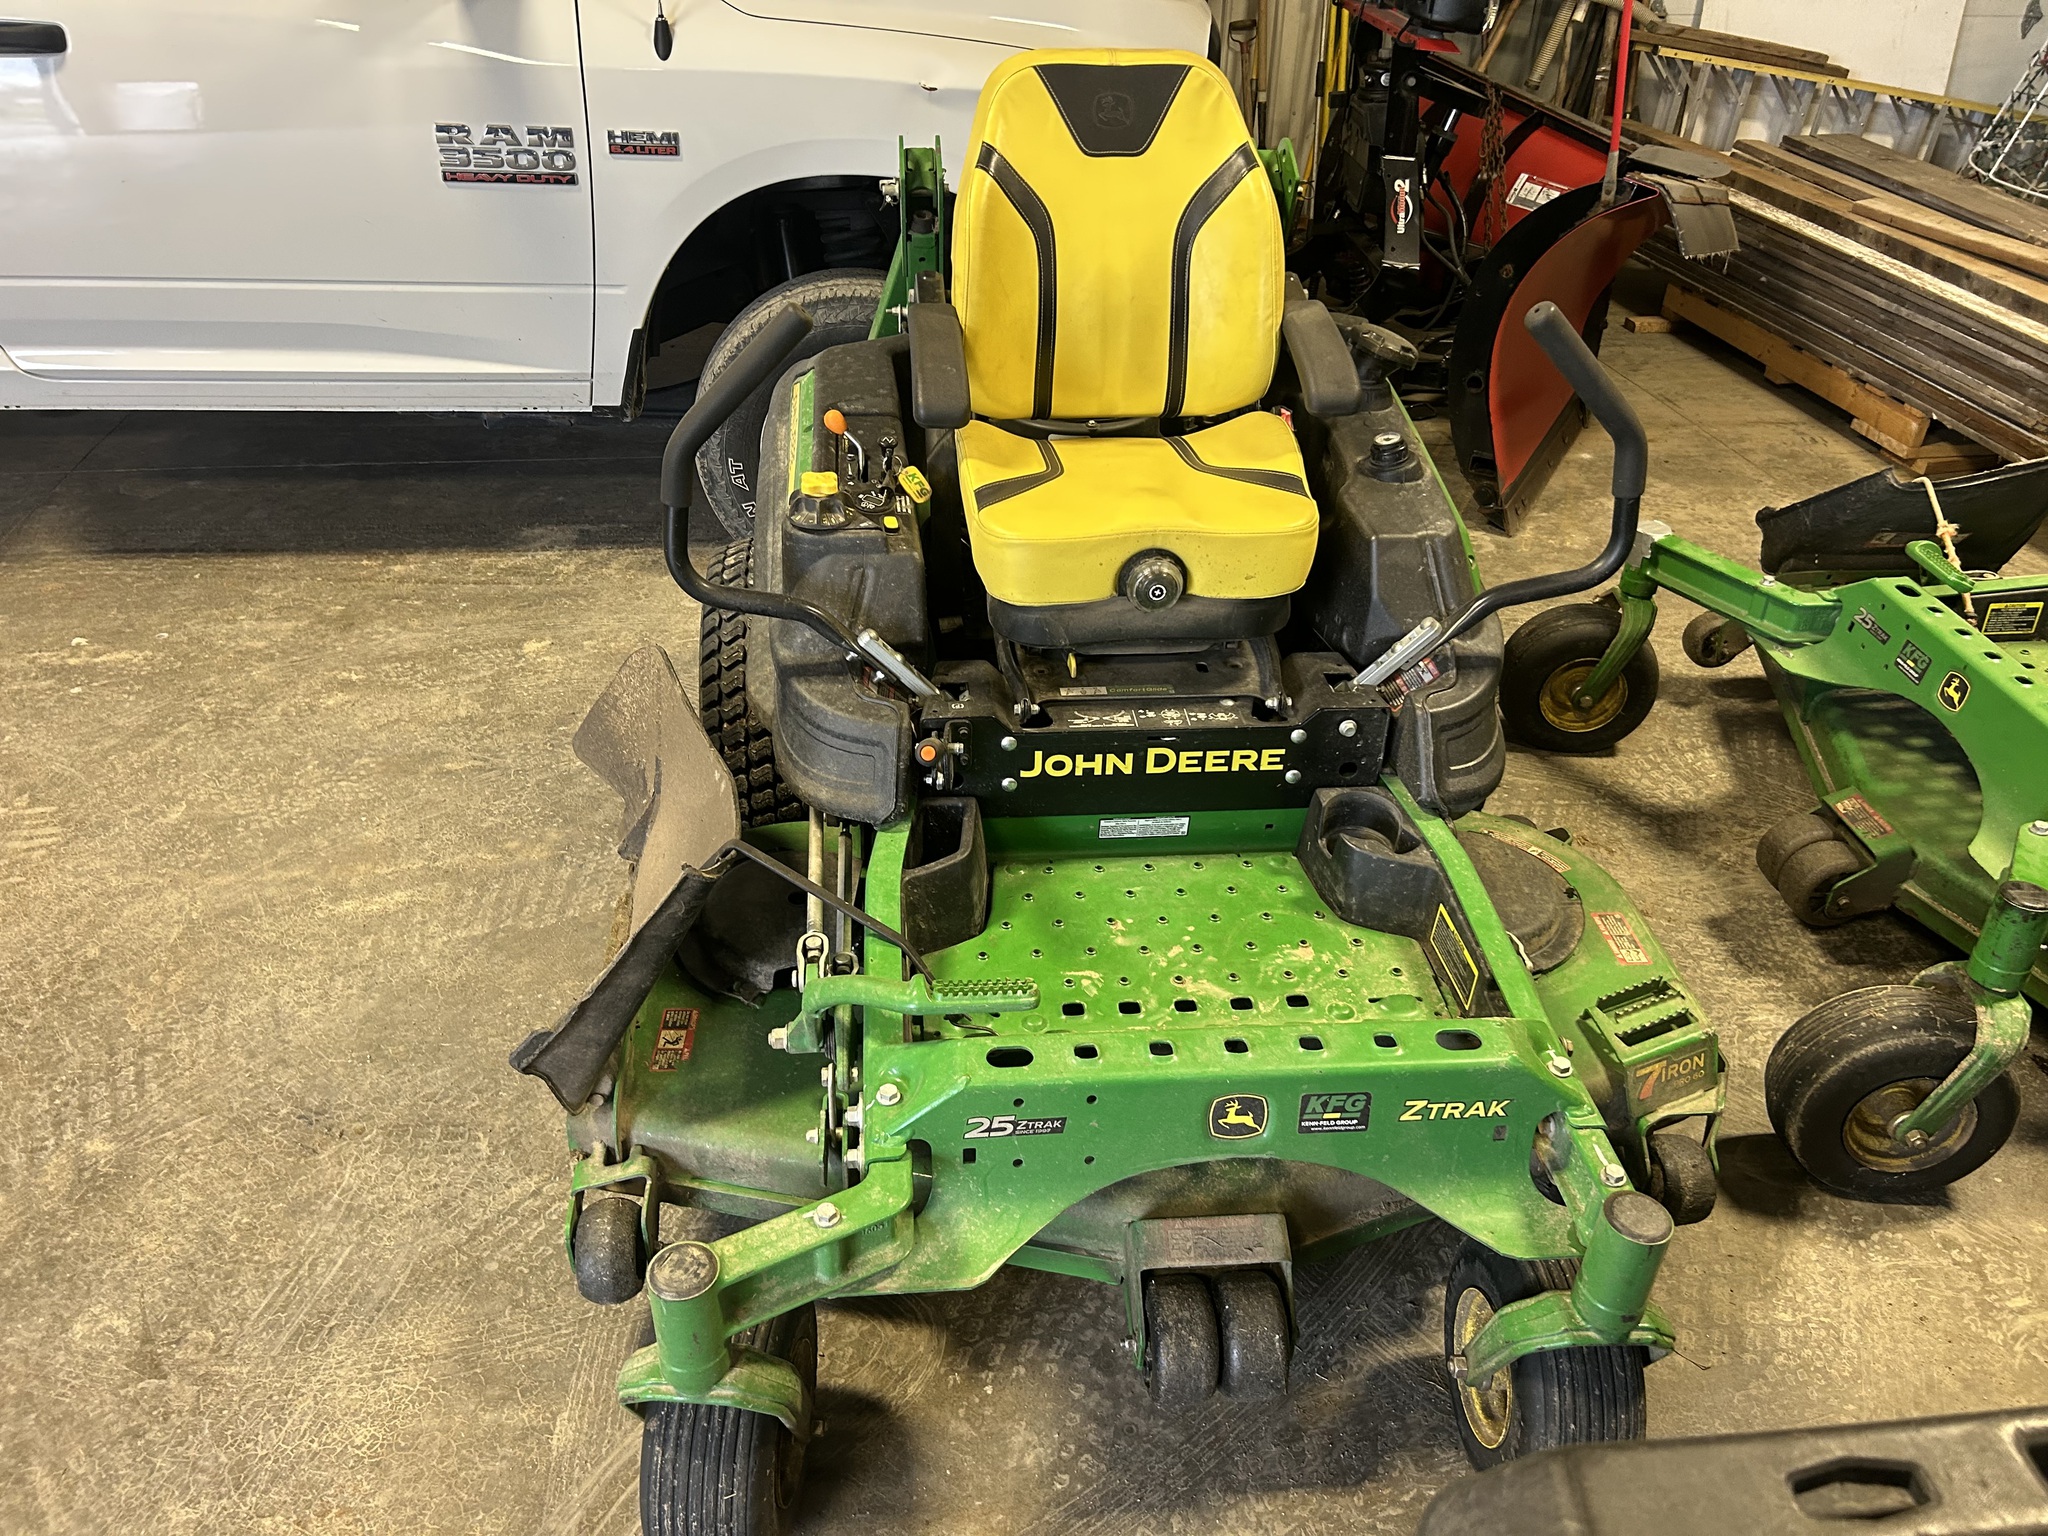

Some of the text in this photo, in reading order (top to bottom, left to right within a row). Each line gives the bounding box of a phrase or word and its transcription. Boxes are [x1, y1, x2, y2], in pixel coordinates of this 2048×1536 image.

[434, 121, 575, 149] RAM
[607, 129, 680, 146] HEMI
[438, 145, 577, 172] 3500
[610, 145, 677, 155] 6.4 LITER
[445, 171, 572, 184] HEAVY DUTY
[728, 457, 750, 492] AT
[908, 472, 931, 497] KFG
[1853, 606, 1876, 630] 25
[1902, 643, 1930, 669] KFG
[1019, 747, 1286, 778] JOHN DEERE
[1635, 1053, 1705, 1100] 7 IRON
[1305, 1094, 1367, 1113] KFG
[1399, 1099, 1512, 1122] ZTRAK
[963, 1115, 1062, 1139] 25 ZTRAK
